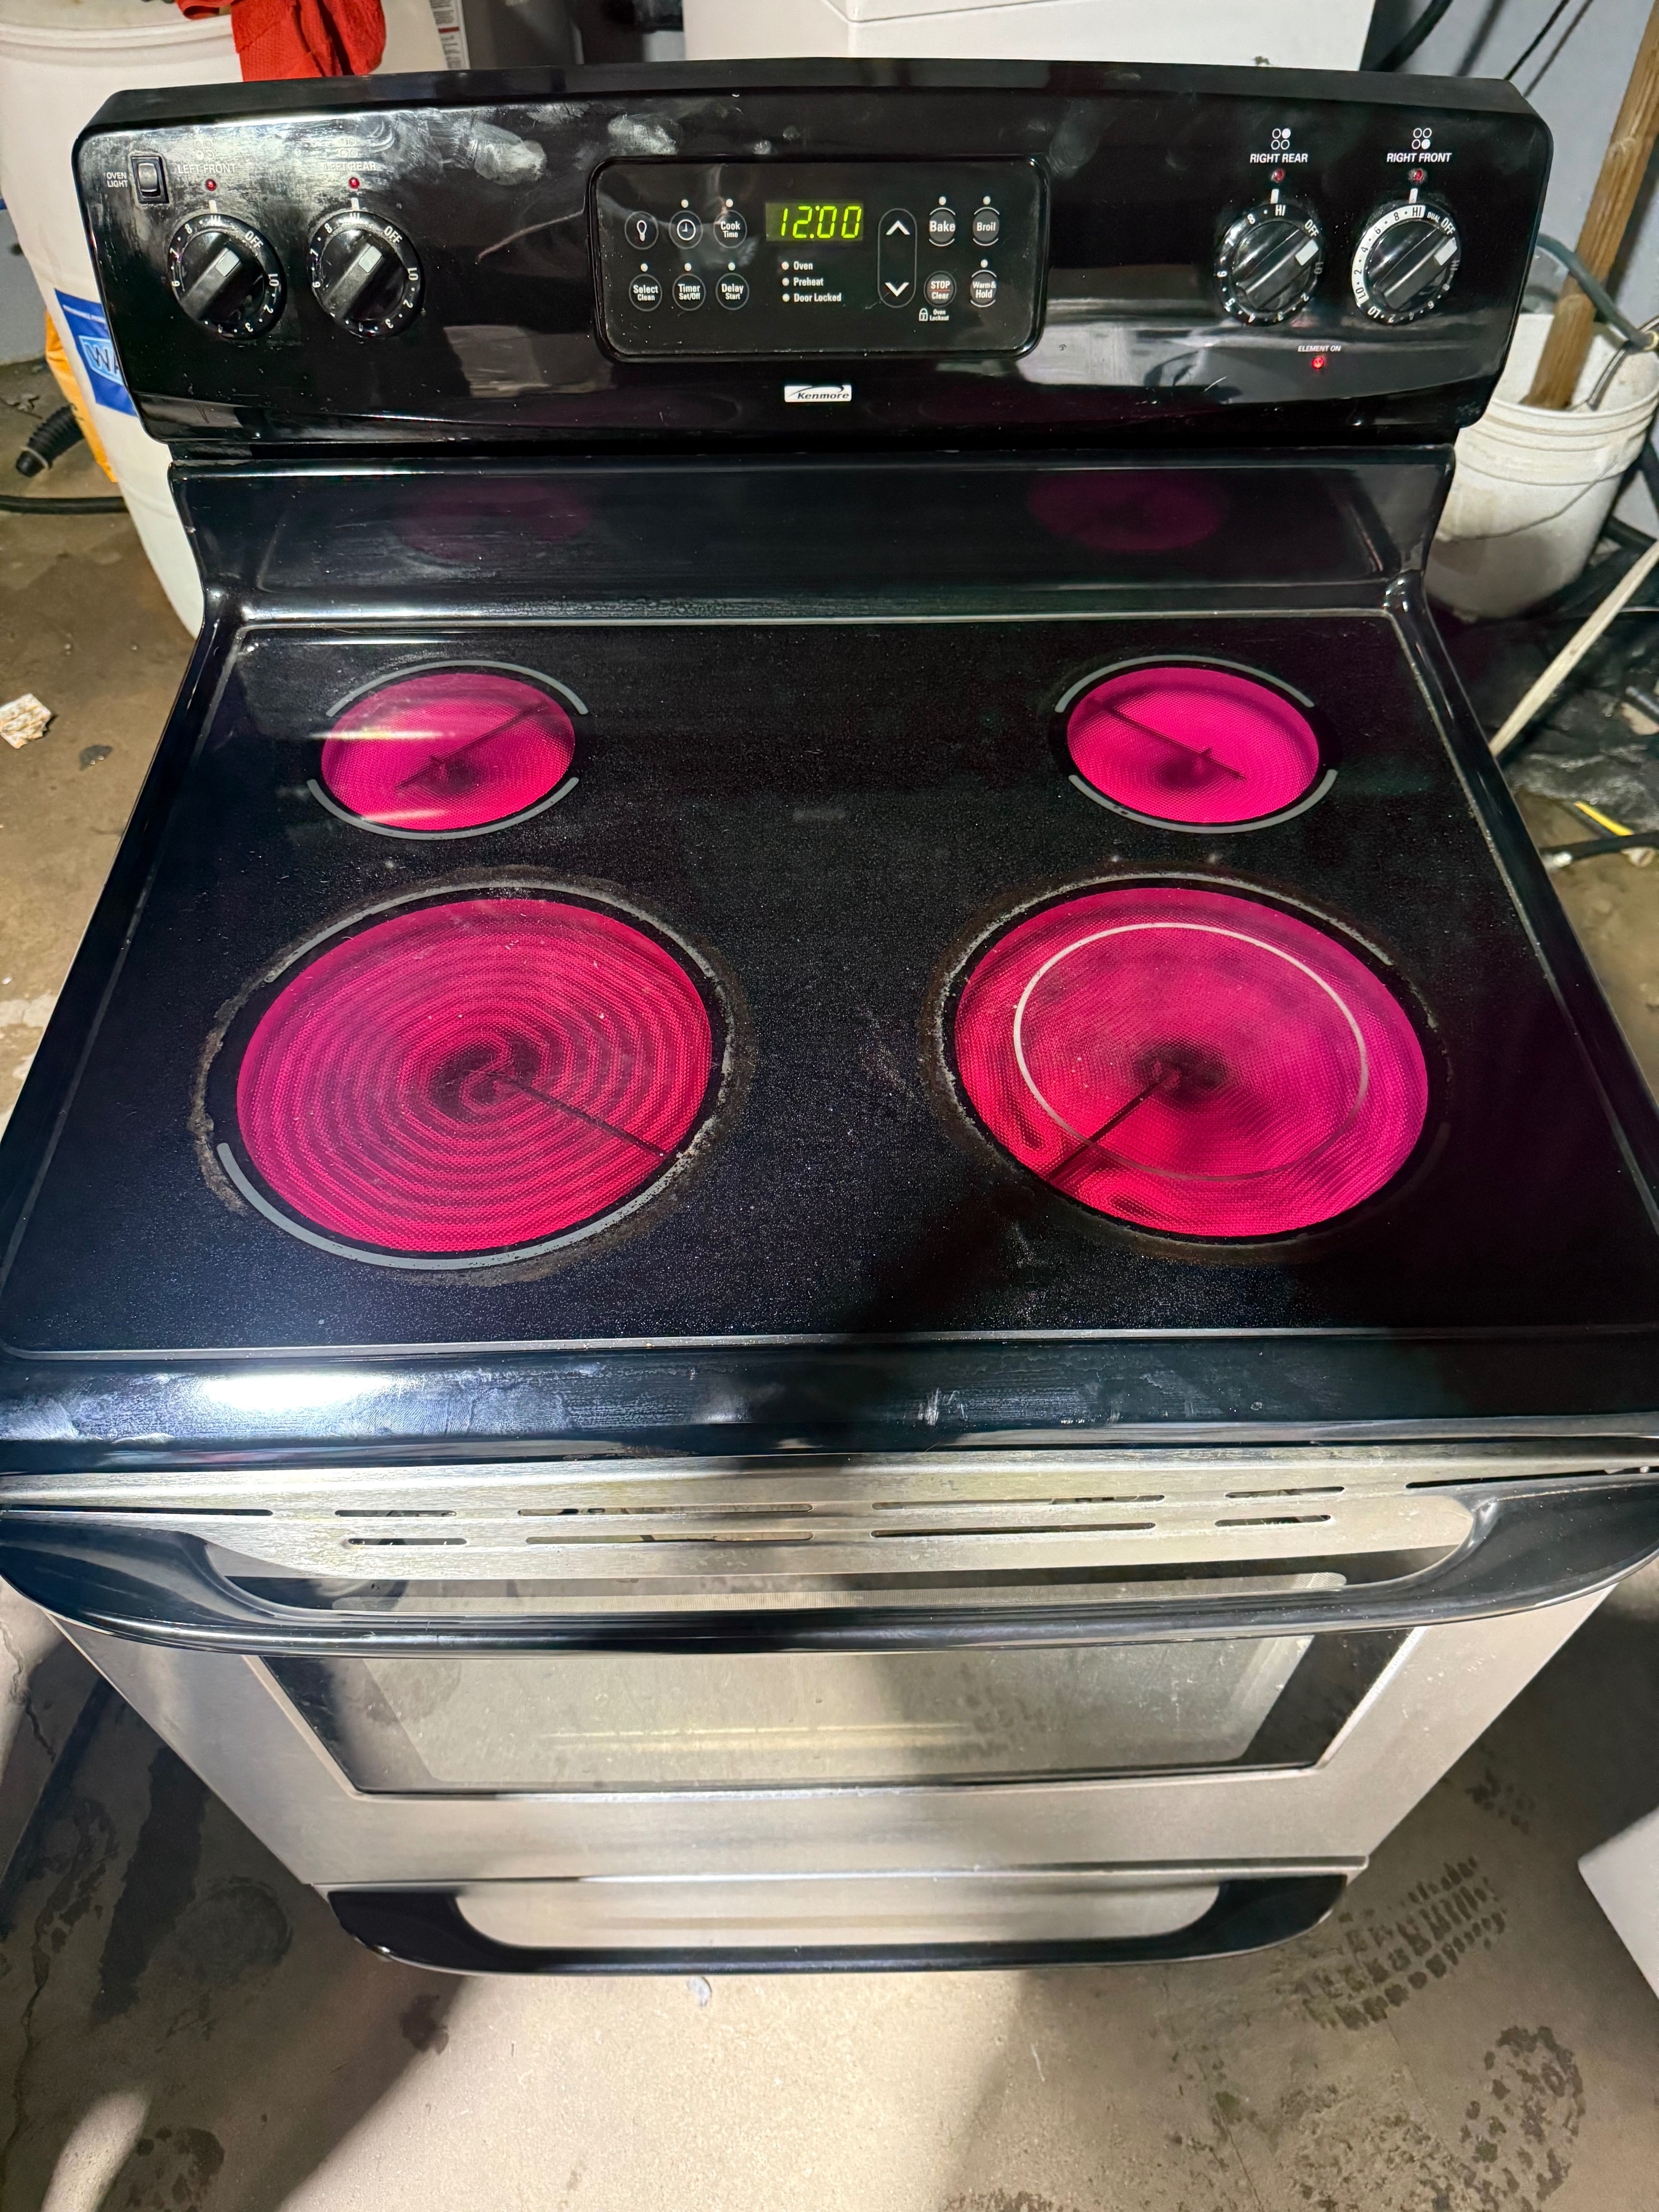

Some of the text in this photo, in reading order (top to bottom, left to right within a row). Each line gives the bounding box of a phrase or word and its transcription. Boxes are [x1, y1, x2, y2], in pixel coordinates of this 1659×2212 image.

[1250, 153, 1308, 163] RIGHT REAR
[1386, 153, 1452, 163] RIGHT FRONT
[178, 164, 236, 174] LEFT FRONT
[325, 161, 376, 171] LEFT REAR
[107, 180, 128, 188] LIGHT
[1275, 204, 1286, 216] HI
[1412, 207, 1422, 216] HI
[1247, 213, 1255, 224] 8
[1394, 212, 1399, 221] 8
[1427, 212, 1440, 223] DUAL
[721, 221, 740, 230] Cook
[781, 206, 862, 239] 12:00
[929, 221, 955, 232] Bake
[976, 222, 996, 232] Broil
[1441, 218, 1455, 235] OFF
[185, 223, 192, 234] 8
[324, 223, 333, 233] 8
[1304, 219, 1319, 237] OFF
[1374, 226, 1381, 234] 6
[245, 230, 264, 248] OFF
[384, 226, 402, 243] OFF
[310, 248, 319, 257] 7
[793, 261, 813, 270] Oven
[793, 277, 824, 286] Preheat
[931, 281, 950, 289] STOP
[633, 285, 658, 294] Select
[678, 284, 700, 293] Timer
[721, 283, 744, 294] Delay
[1355, 287, 1366, 299] LO
[679, 292, 700, 301] Set/Off
[793, 292, 842, 302] Door Locked
[931, 292, 949, 300] Clear
[975, 290, 992, 298] Hold
[403, 299, 413, 308] 2
[263, 304, 273, 314] 2
[245, 322, 253, 332] 3
[385, 318, 394, 329] 3
